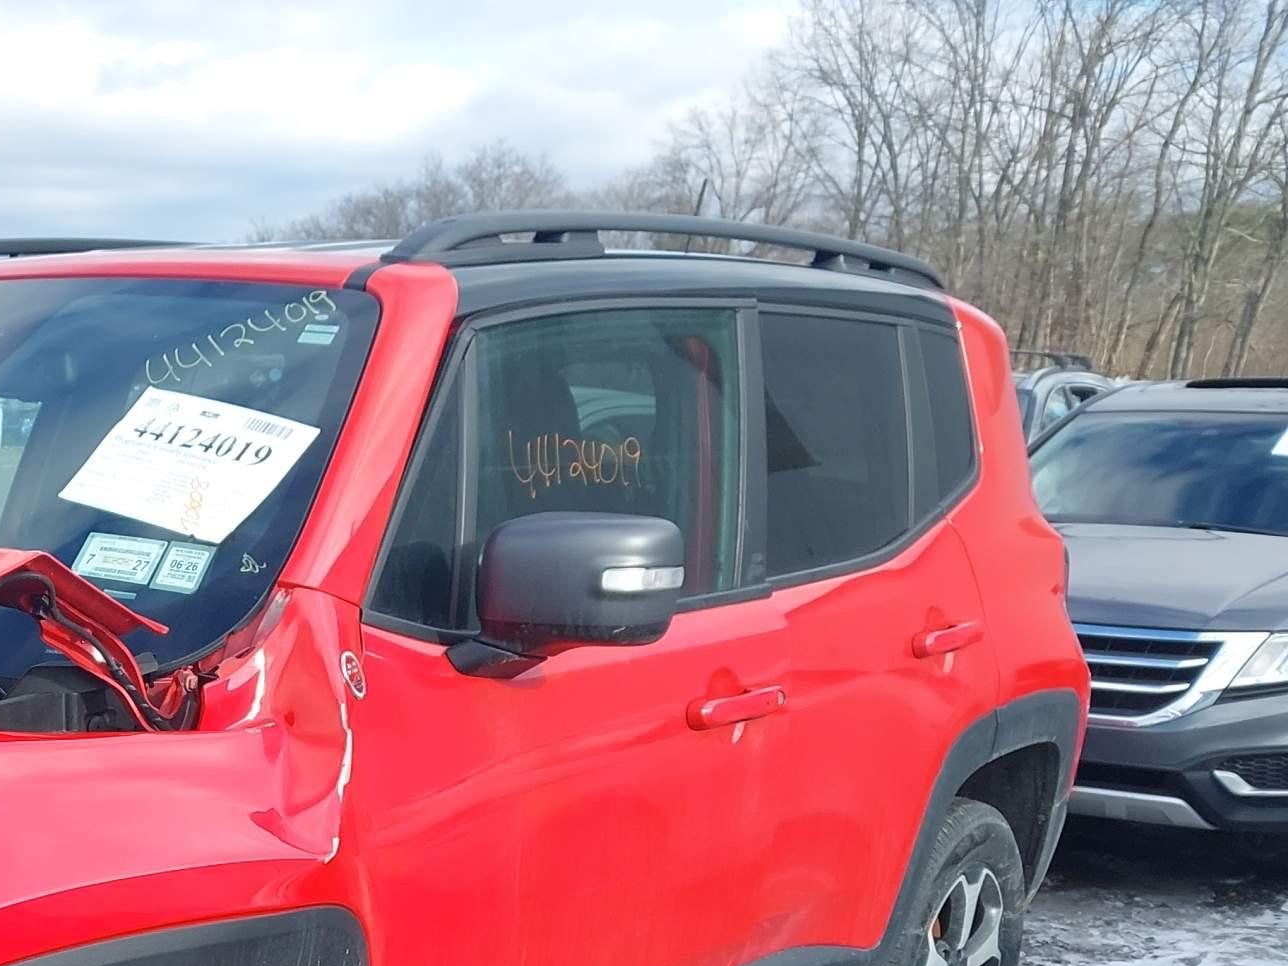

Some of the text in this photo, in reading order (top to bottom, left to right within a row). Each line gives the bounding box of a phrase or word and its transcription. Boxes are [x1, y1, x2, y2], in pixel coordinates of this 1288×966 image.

[145, 290, 338, 386] 44124019
[132, 417, 273, 466] 44124019
[508, 430, 642, 499] 44124019
[132, 559, 151, 572] 27
